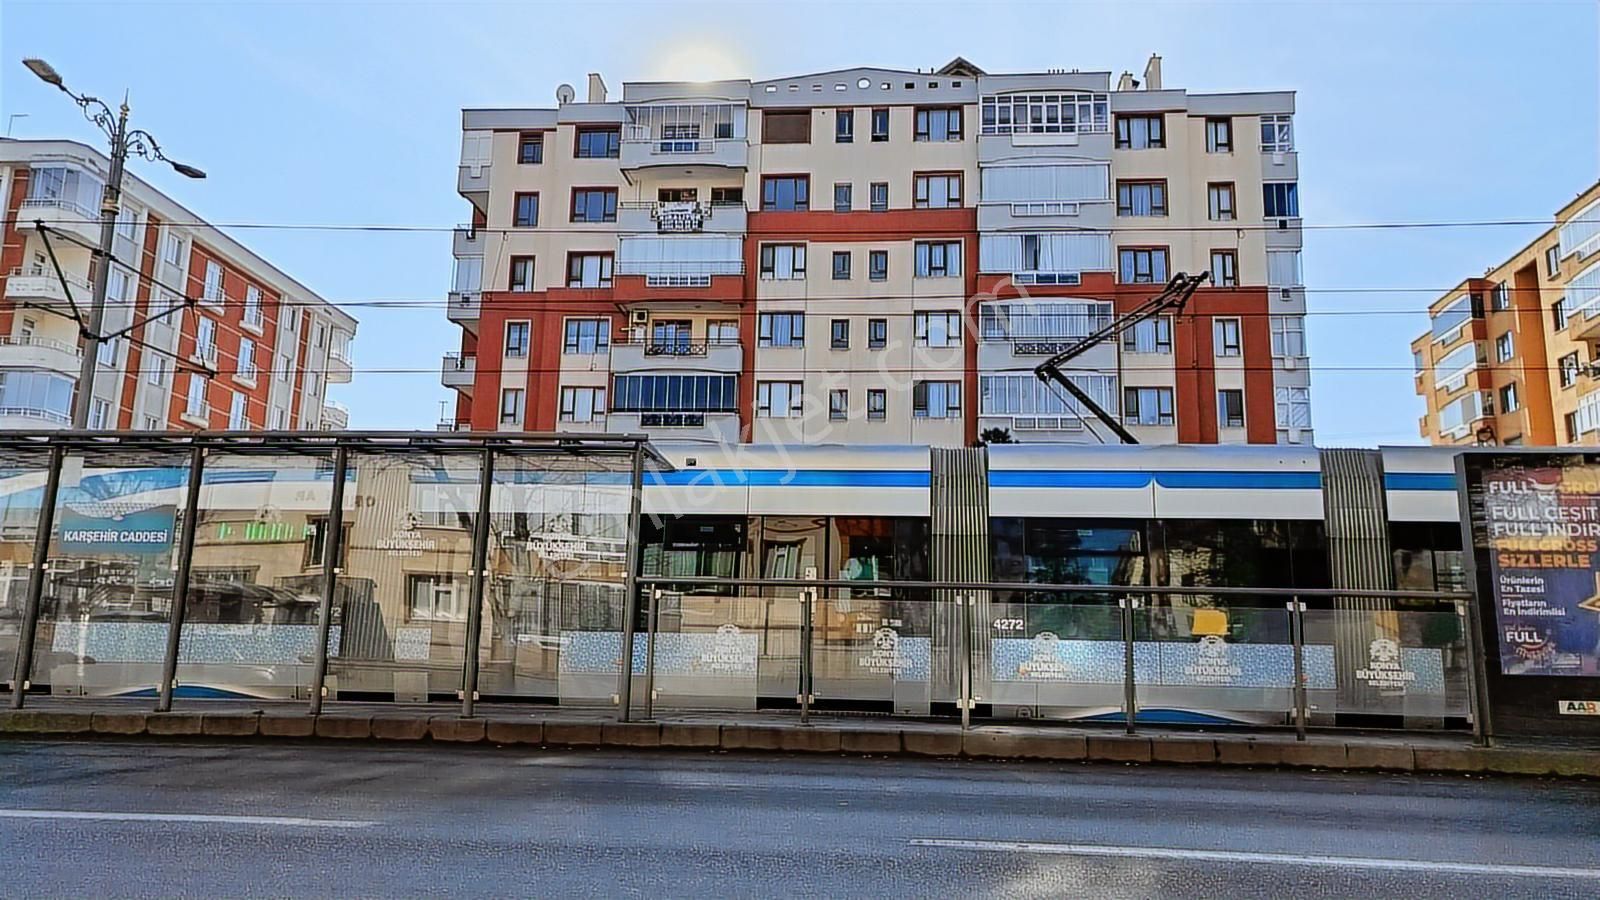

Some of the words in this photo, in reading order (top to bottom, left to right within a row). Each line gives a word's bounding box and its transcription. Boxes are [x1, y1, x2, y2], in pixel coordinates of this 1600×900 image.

[1489, 481, 1533, 493] FULL
[1492, 506, 1540, 520] FULL
[1494, 523, 1542, 537] FULL
[64, 529, 118, 544] KARŞEHİR
[120, 529, 168, 543] CADDESİ
[1498, 554, 1591, 568] SİZLERLE
[1500, 575, 1544, 585] Ürünlerin
[1500, 585, 1513, 593] En
[1515, 585, 1545, 593] Tazesi
[1503, 608, 1516, 616] En
[993, 619, 1024, 630] 4272
[1506, 632, 1543, 642] FULL
